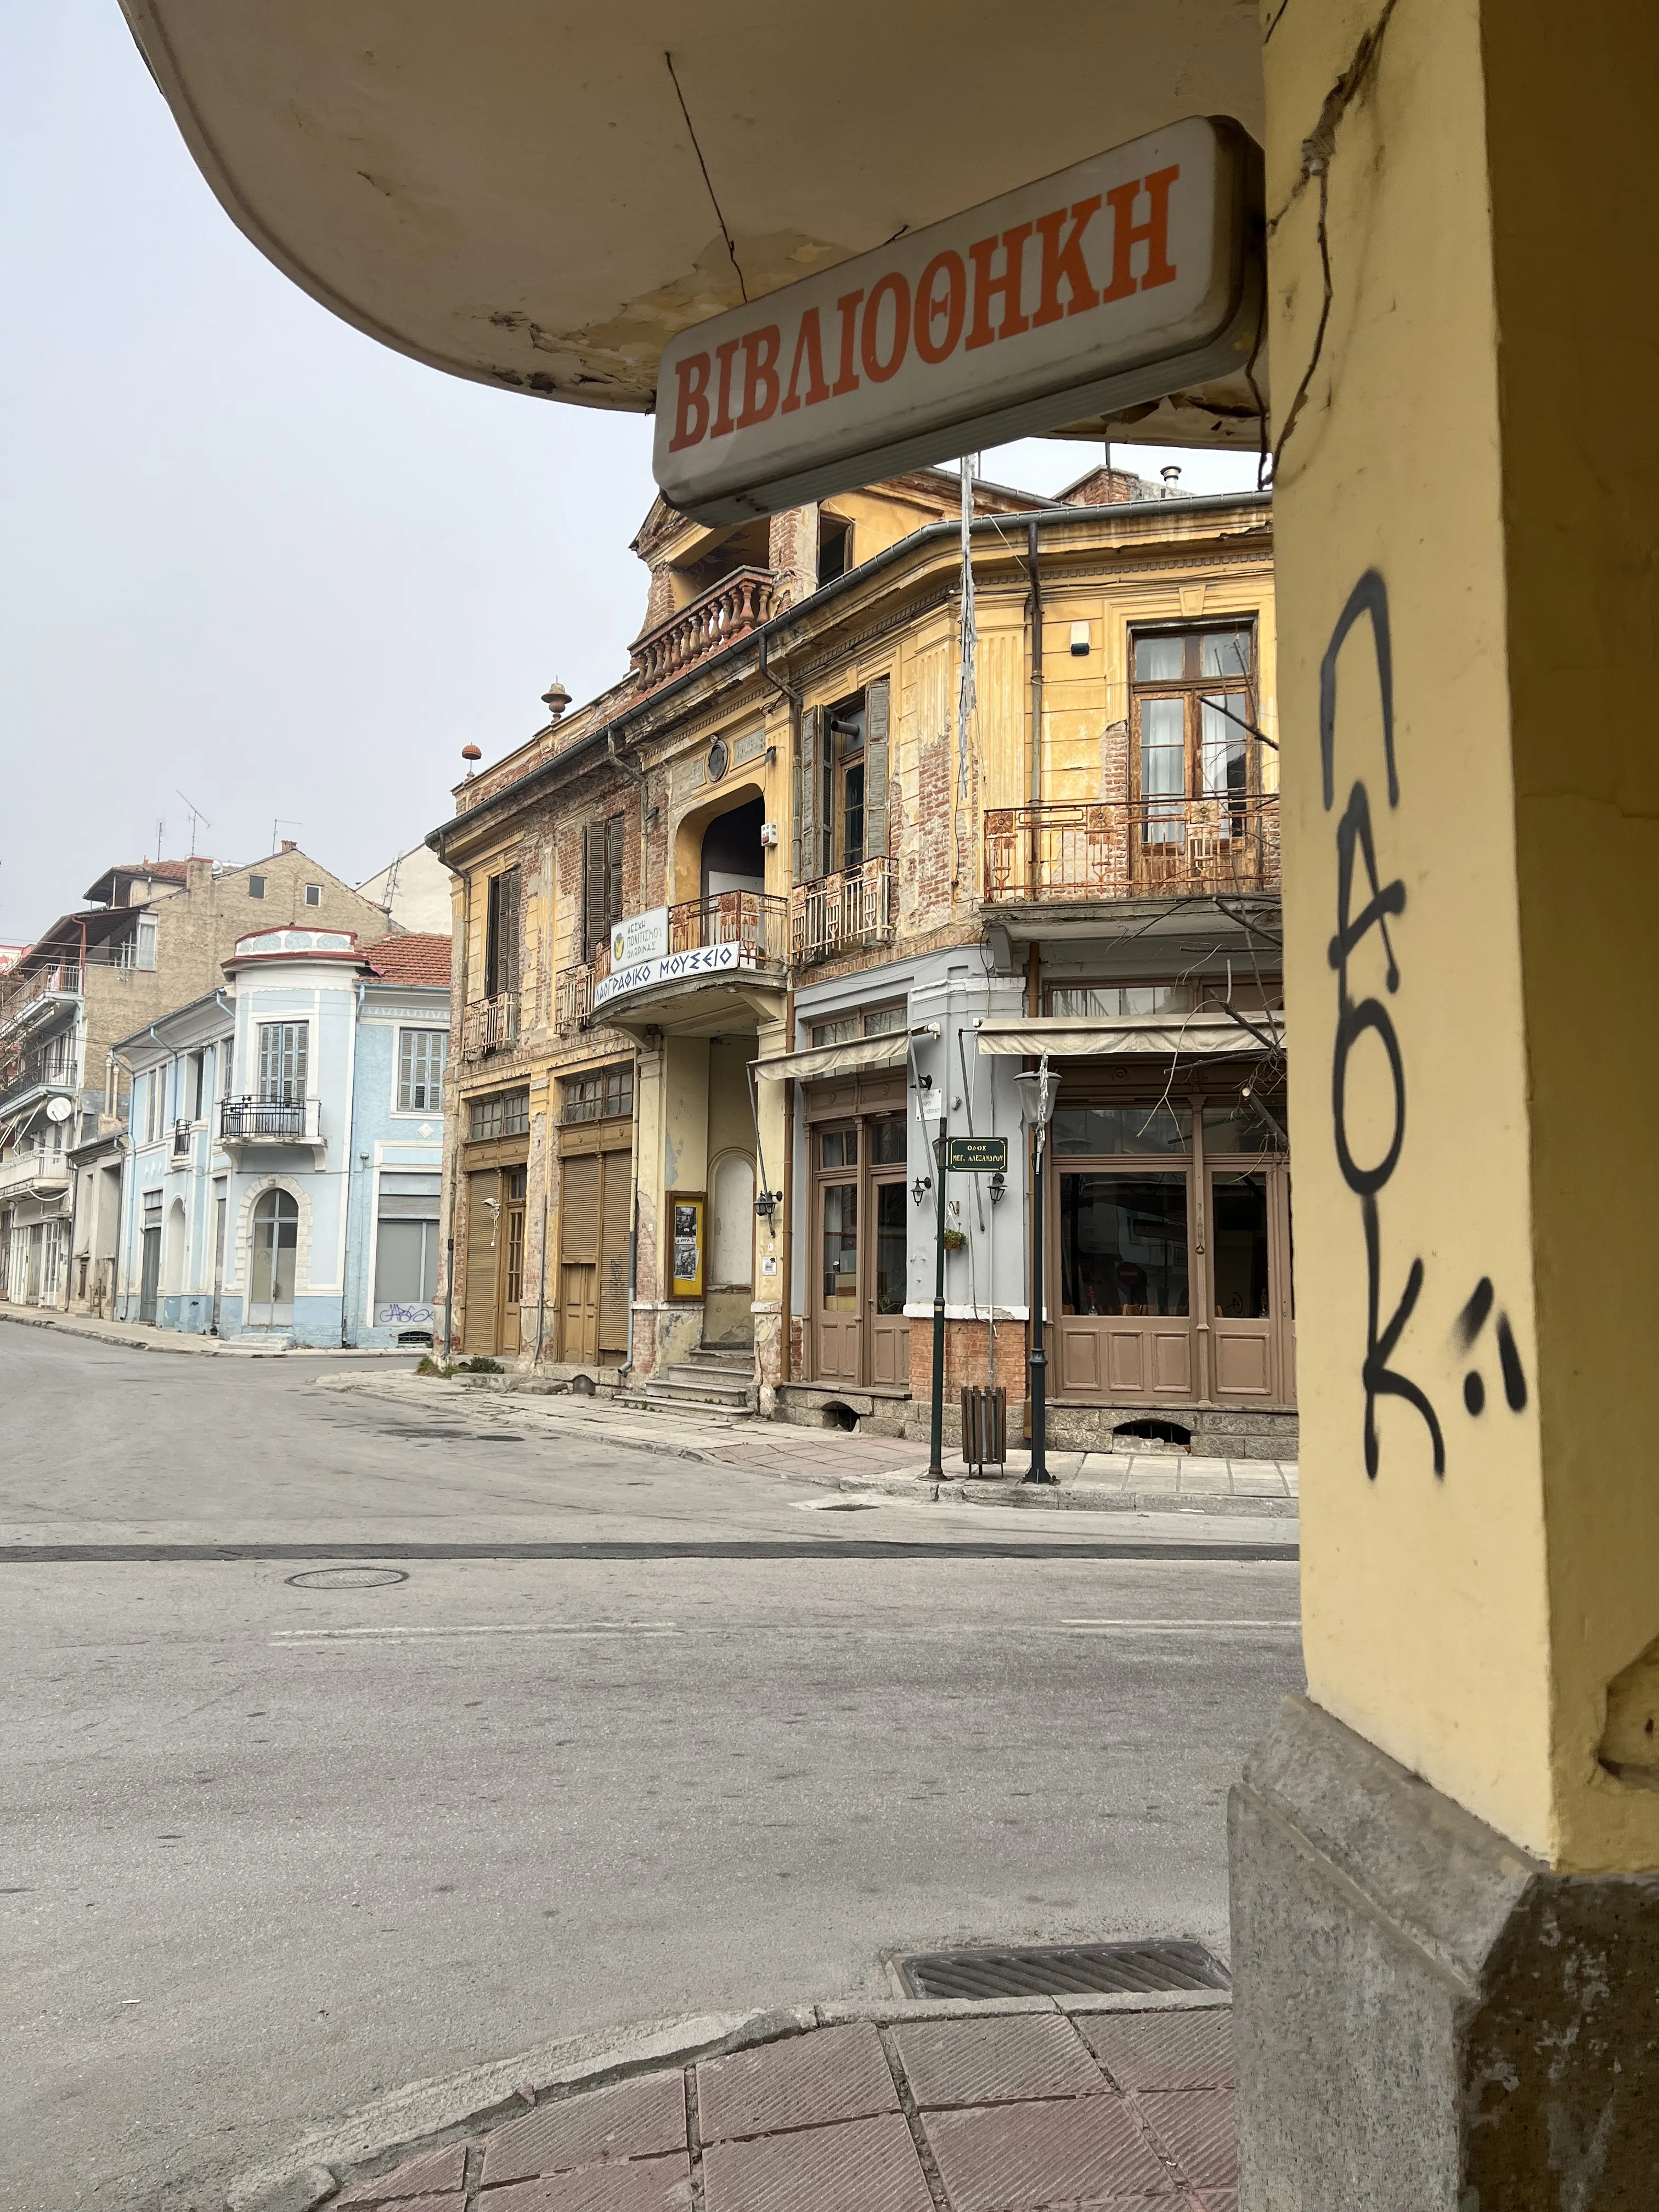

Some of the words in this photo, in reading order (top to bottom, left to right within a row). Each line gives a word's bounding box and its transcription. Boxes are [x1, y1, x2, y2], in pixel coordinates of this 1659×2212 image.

[669, 164, 1180, 453] ΒΙΒΛΙΟΘΗΚΗ
[627, 927, 663, 948] ΠΟΛΙΤΙΣΜΟΥ
[628, 919, 646, 935] ΛΕΣΧΗ
[595, 964, 651, 1005] ΛΑΟΓΡΑΦΙΚΟ
[659, 947, 732, 979] ΜΟΥΣΕΙΟ
